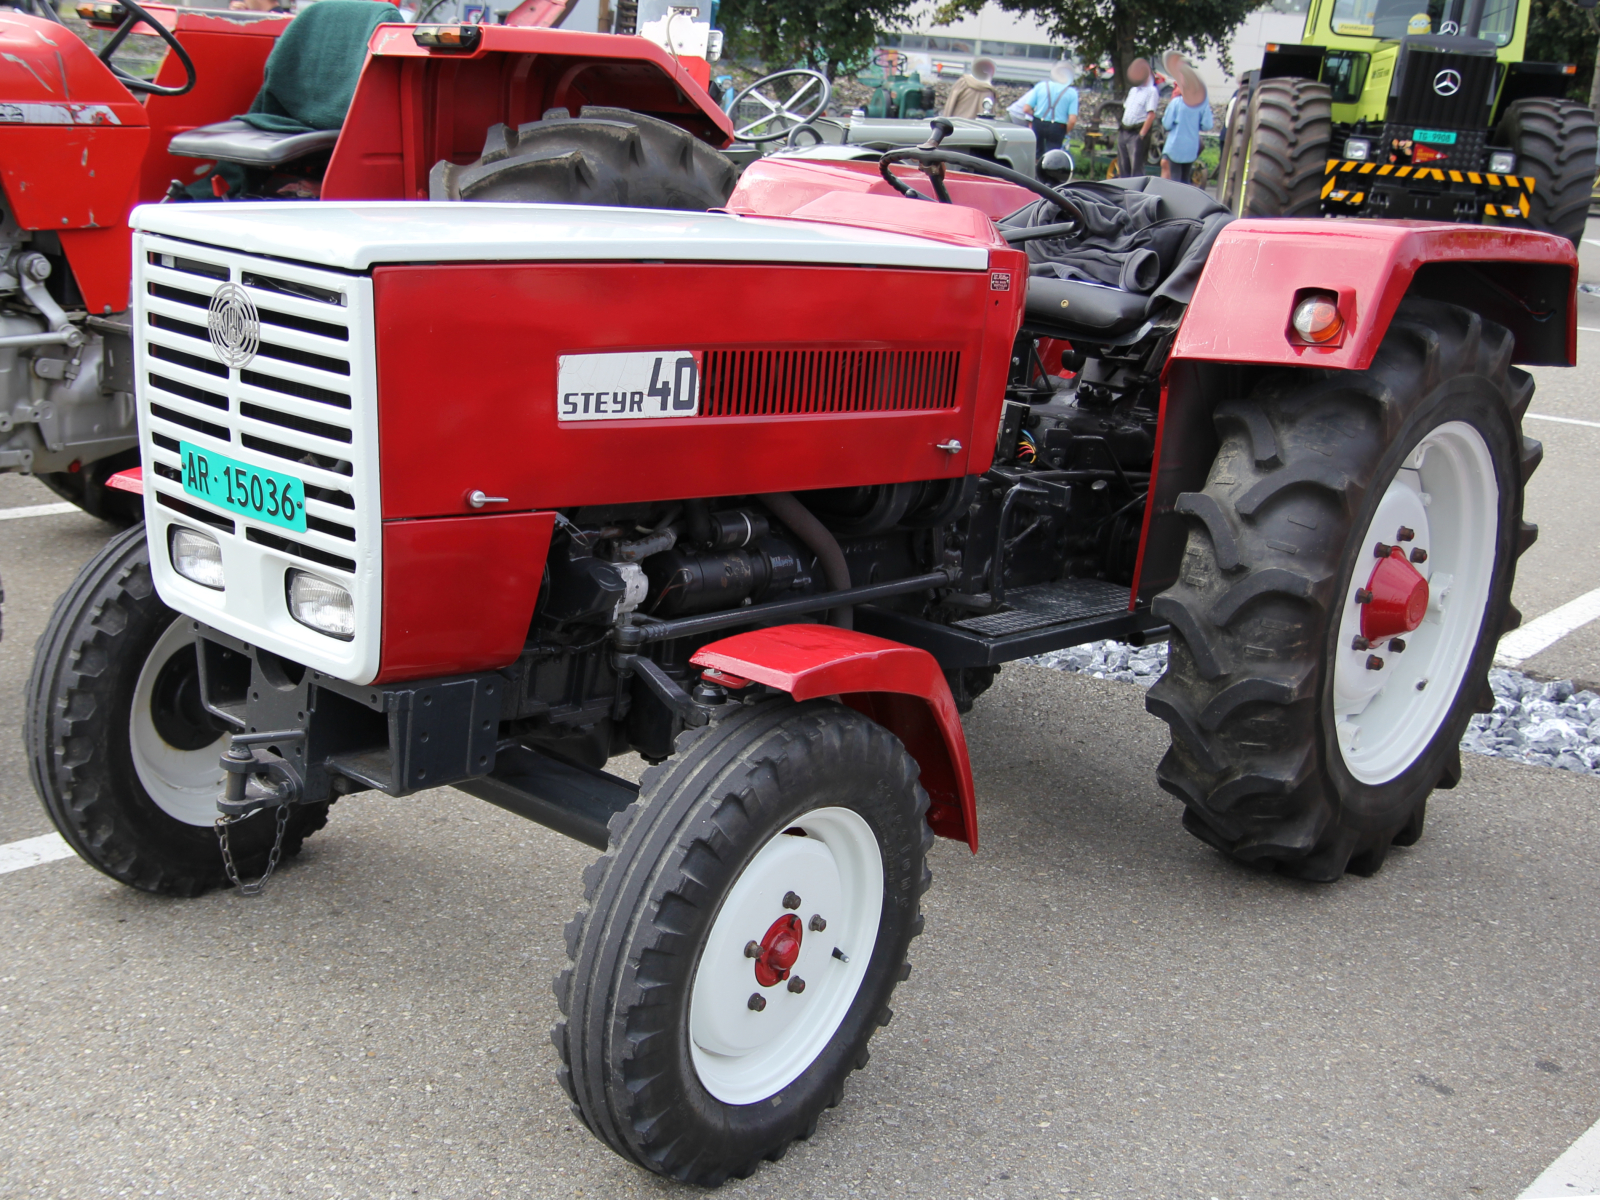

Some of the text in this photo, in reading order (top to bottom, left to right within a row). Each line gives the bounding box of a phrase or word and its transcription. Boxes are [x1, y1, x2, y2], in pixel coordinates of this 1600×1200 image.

[562, 357, 698, 415] STEYR 40
[188, 451, 295, 521] AR 15036
